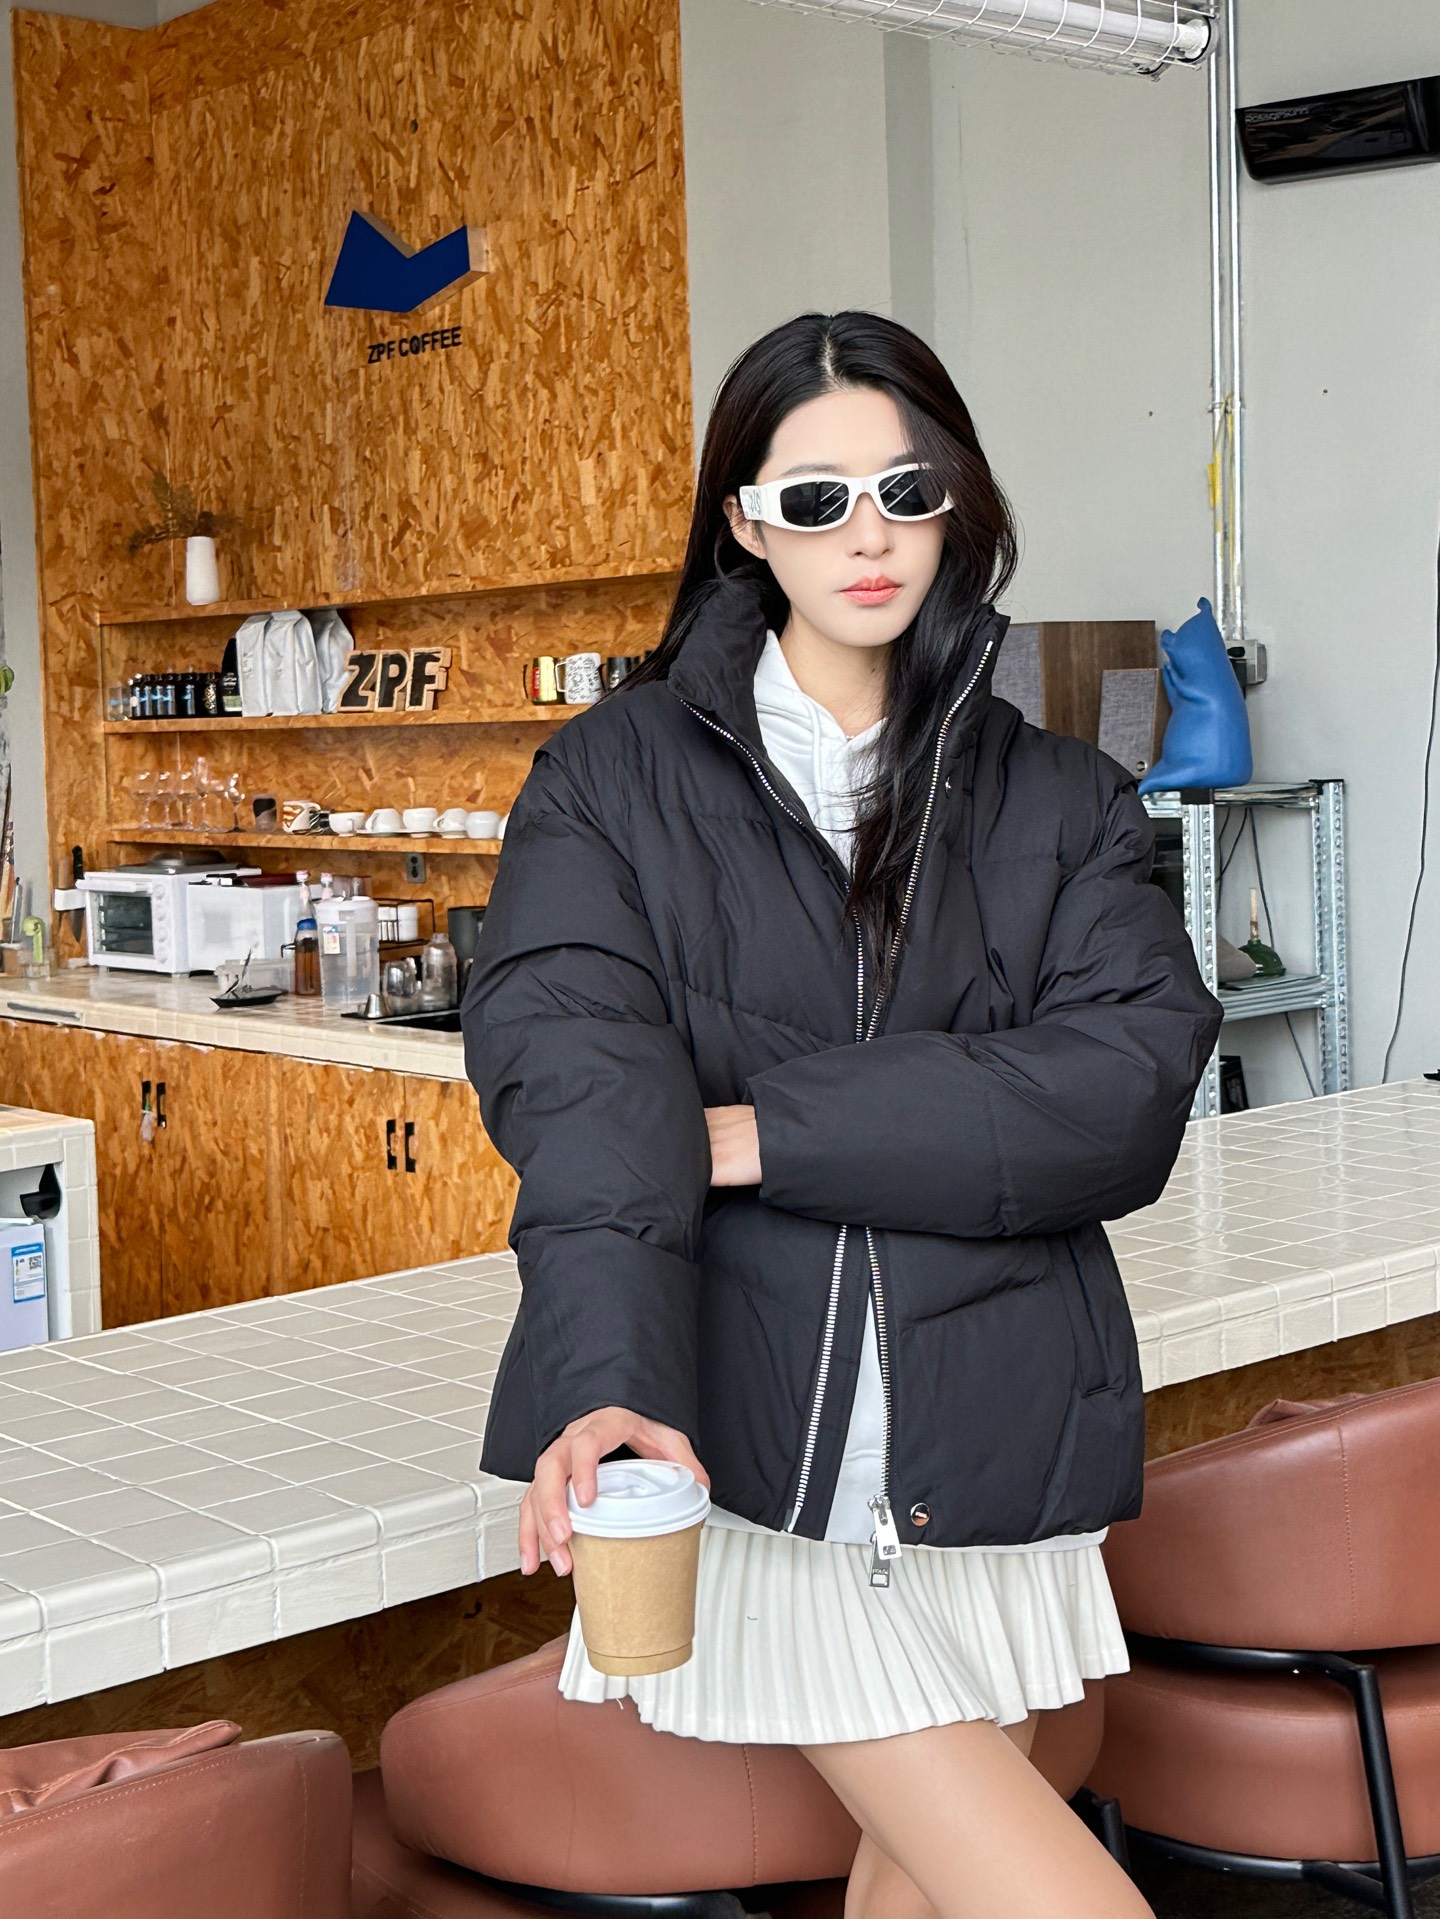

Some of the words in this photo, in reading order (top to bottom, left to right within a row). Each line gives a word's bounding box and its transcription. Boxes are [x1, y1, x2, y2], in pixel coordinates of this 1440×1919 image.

[367, 340, 396, 364] ZPF
[398, 326, 462, 357] COFFEE
[338, 648, 446, 711] ZPF
